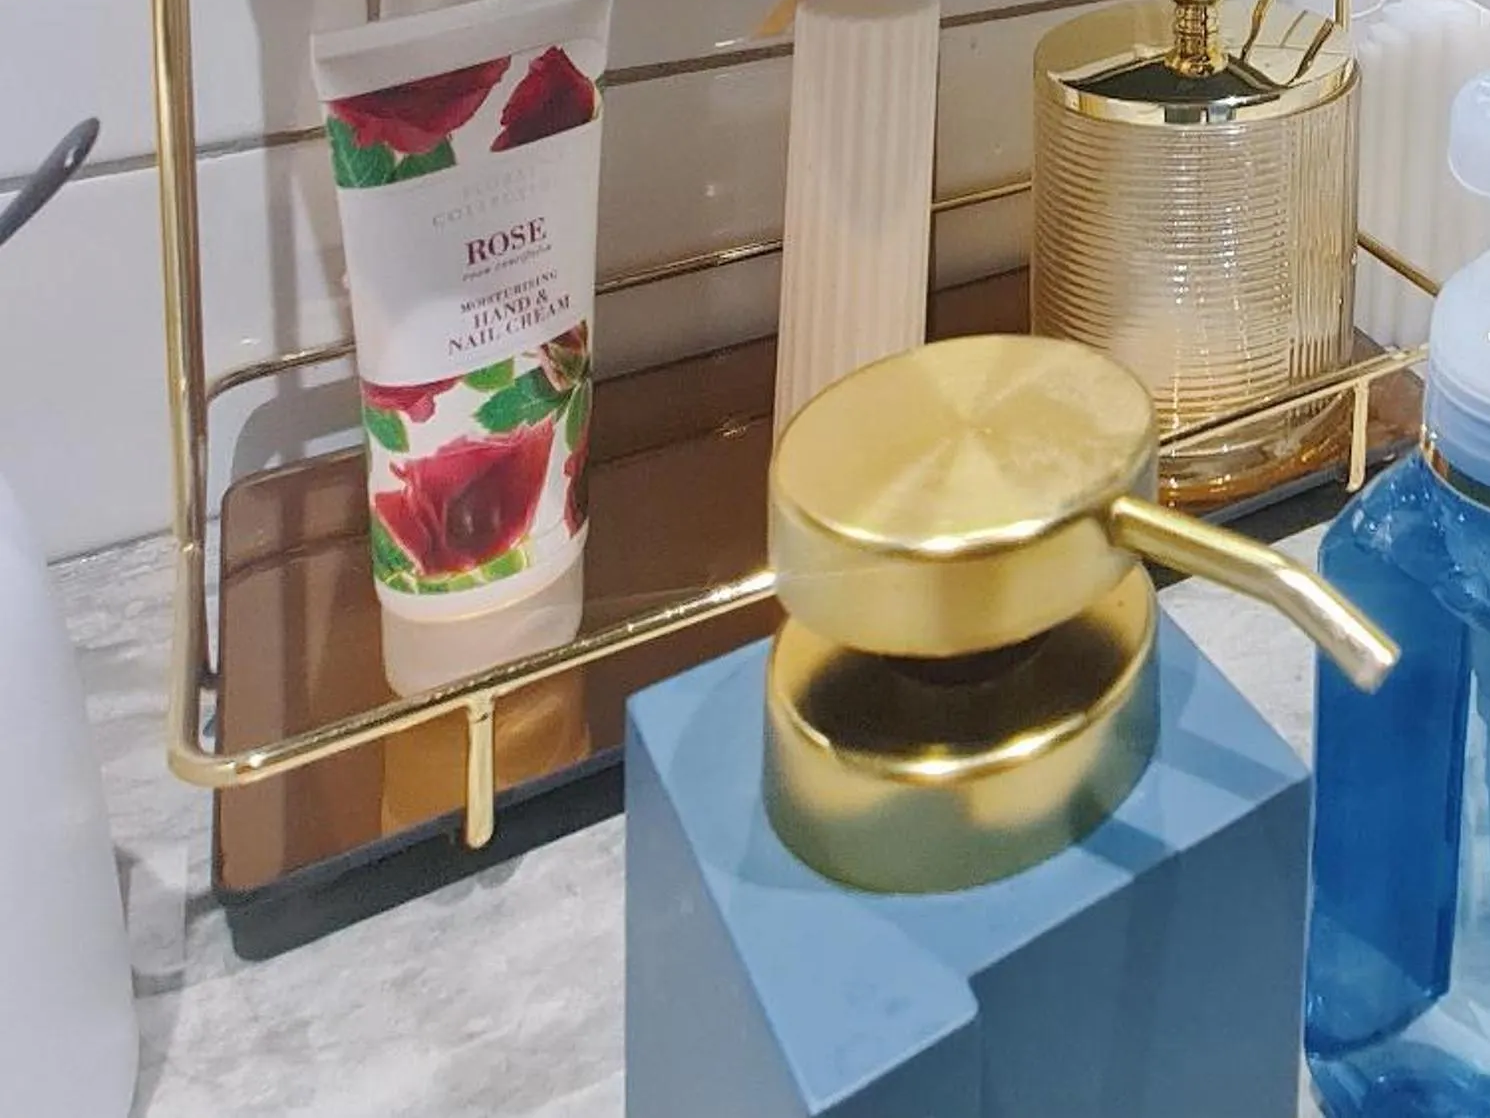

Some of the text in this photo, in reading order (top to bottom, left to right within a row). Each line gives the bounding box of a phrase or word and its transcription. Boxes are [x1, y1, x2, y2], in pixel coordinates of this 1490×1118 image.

[464, 217, 548, 266] ROSE
[448, 294, 570, 356] NAIL CREAM
[473, 288, 548, 330] HAND &
